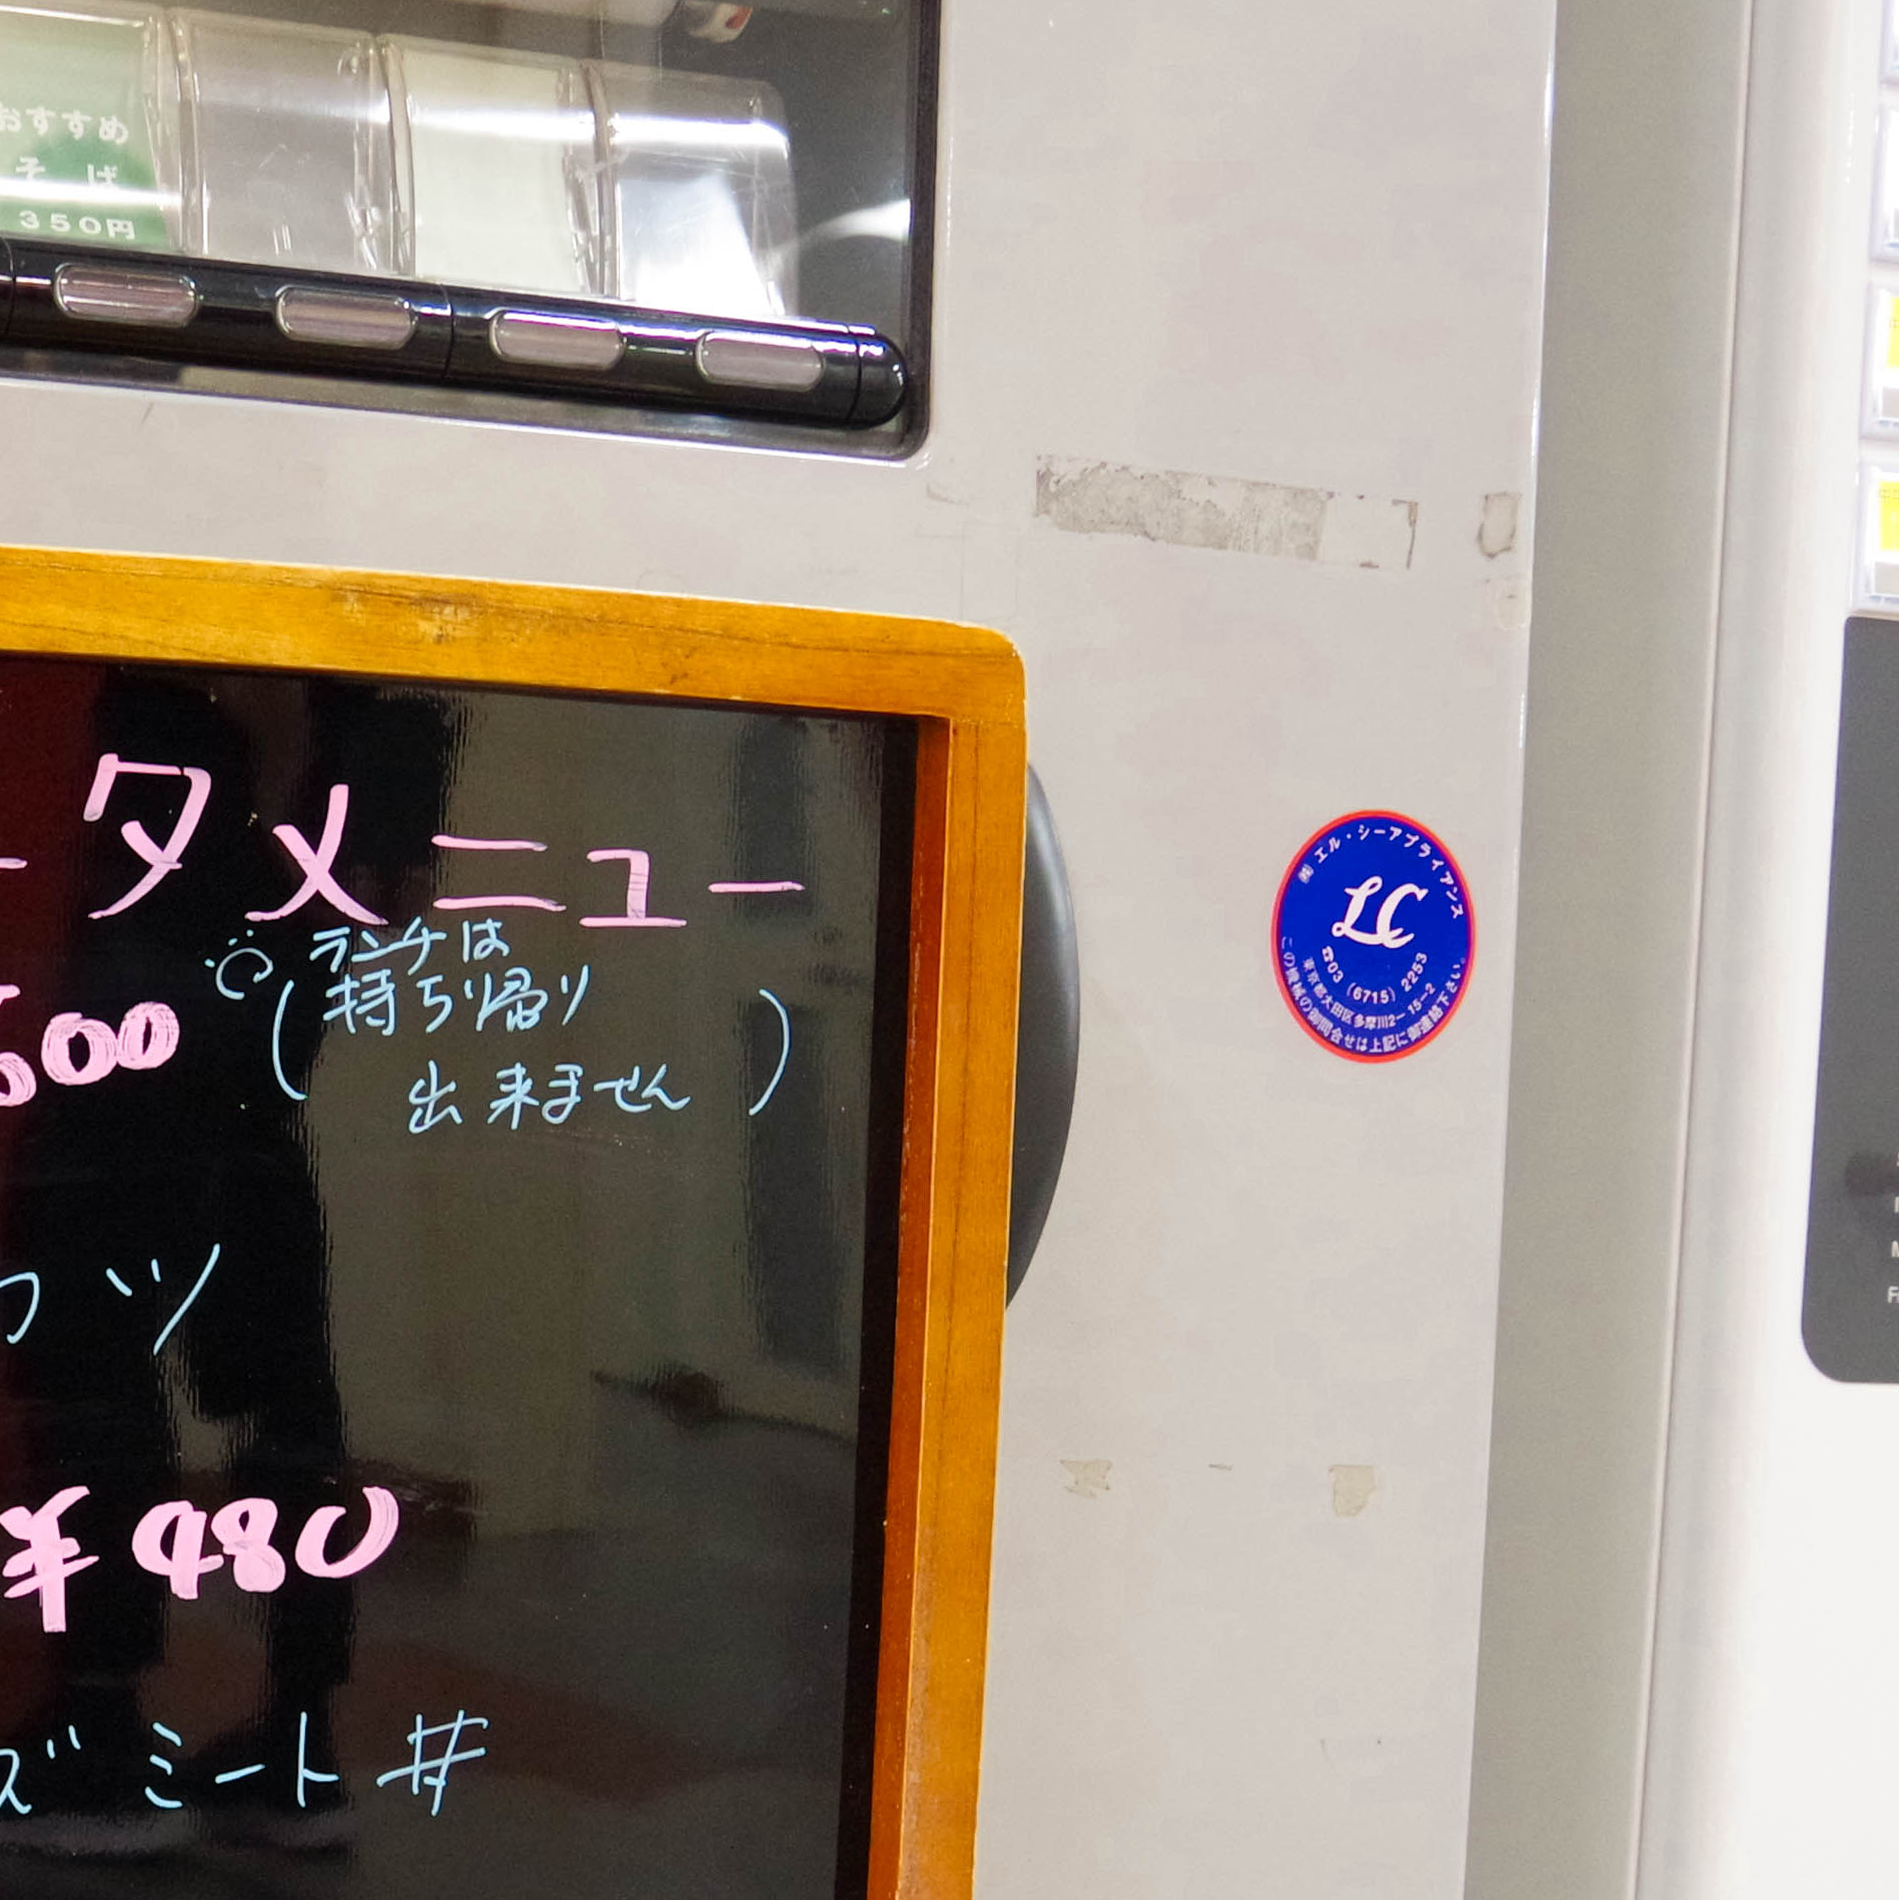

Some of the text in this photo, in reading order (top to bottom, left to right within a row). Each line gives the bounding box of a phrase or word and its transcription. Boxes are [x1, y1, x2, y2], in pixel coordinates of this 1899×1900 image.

[19, 210, 136, 240] 350円
[1331, 875, 1429, 949] LC
[309, 916, 511, 975] ランチは
